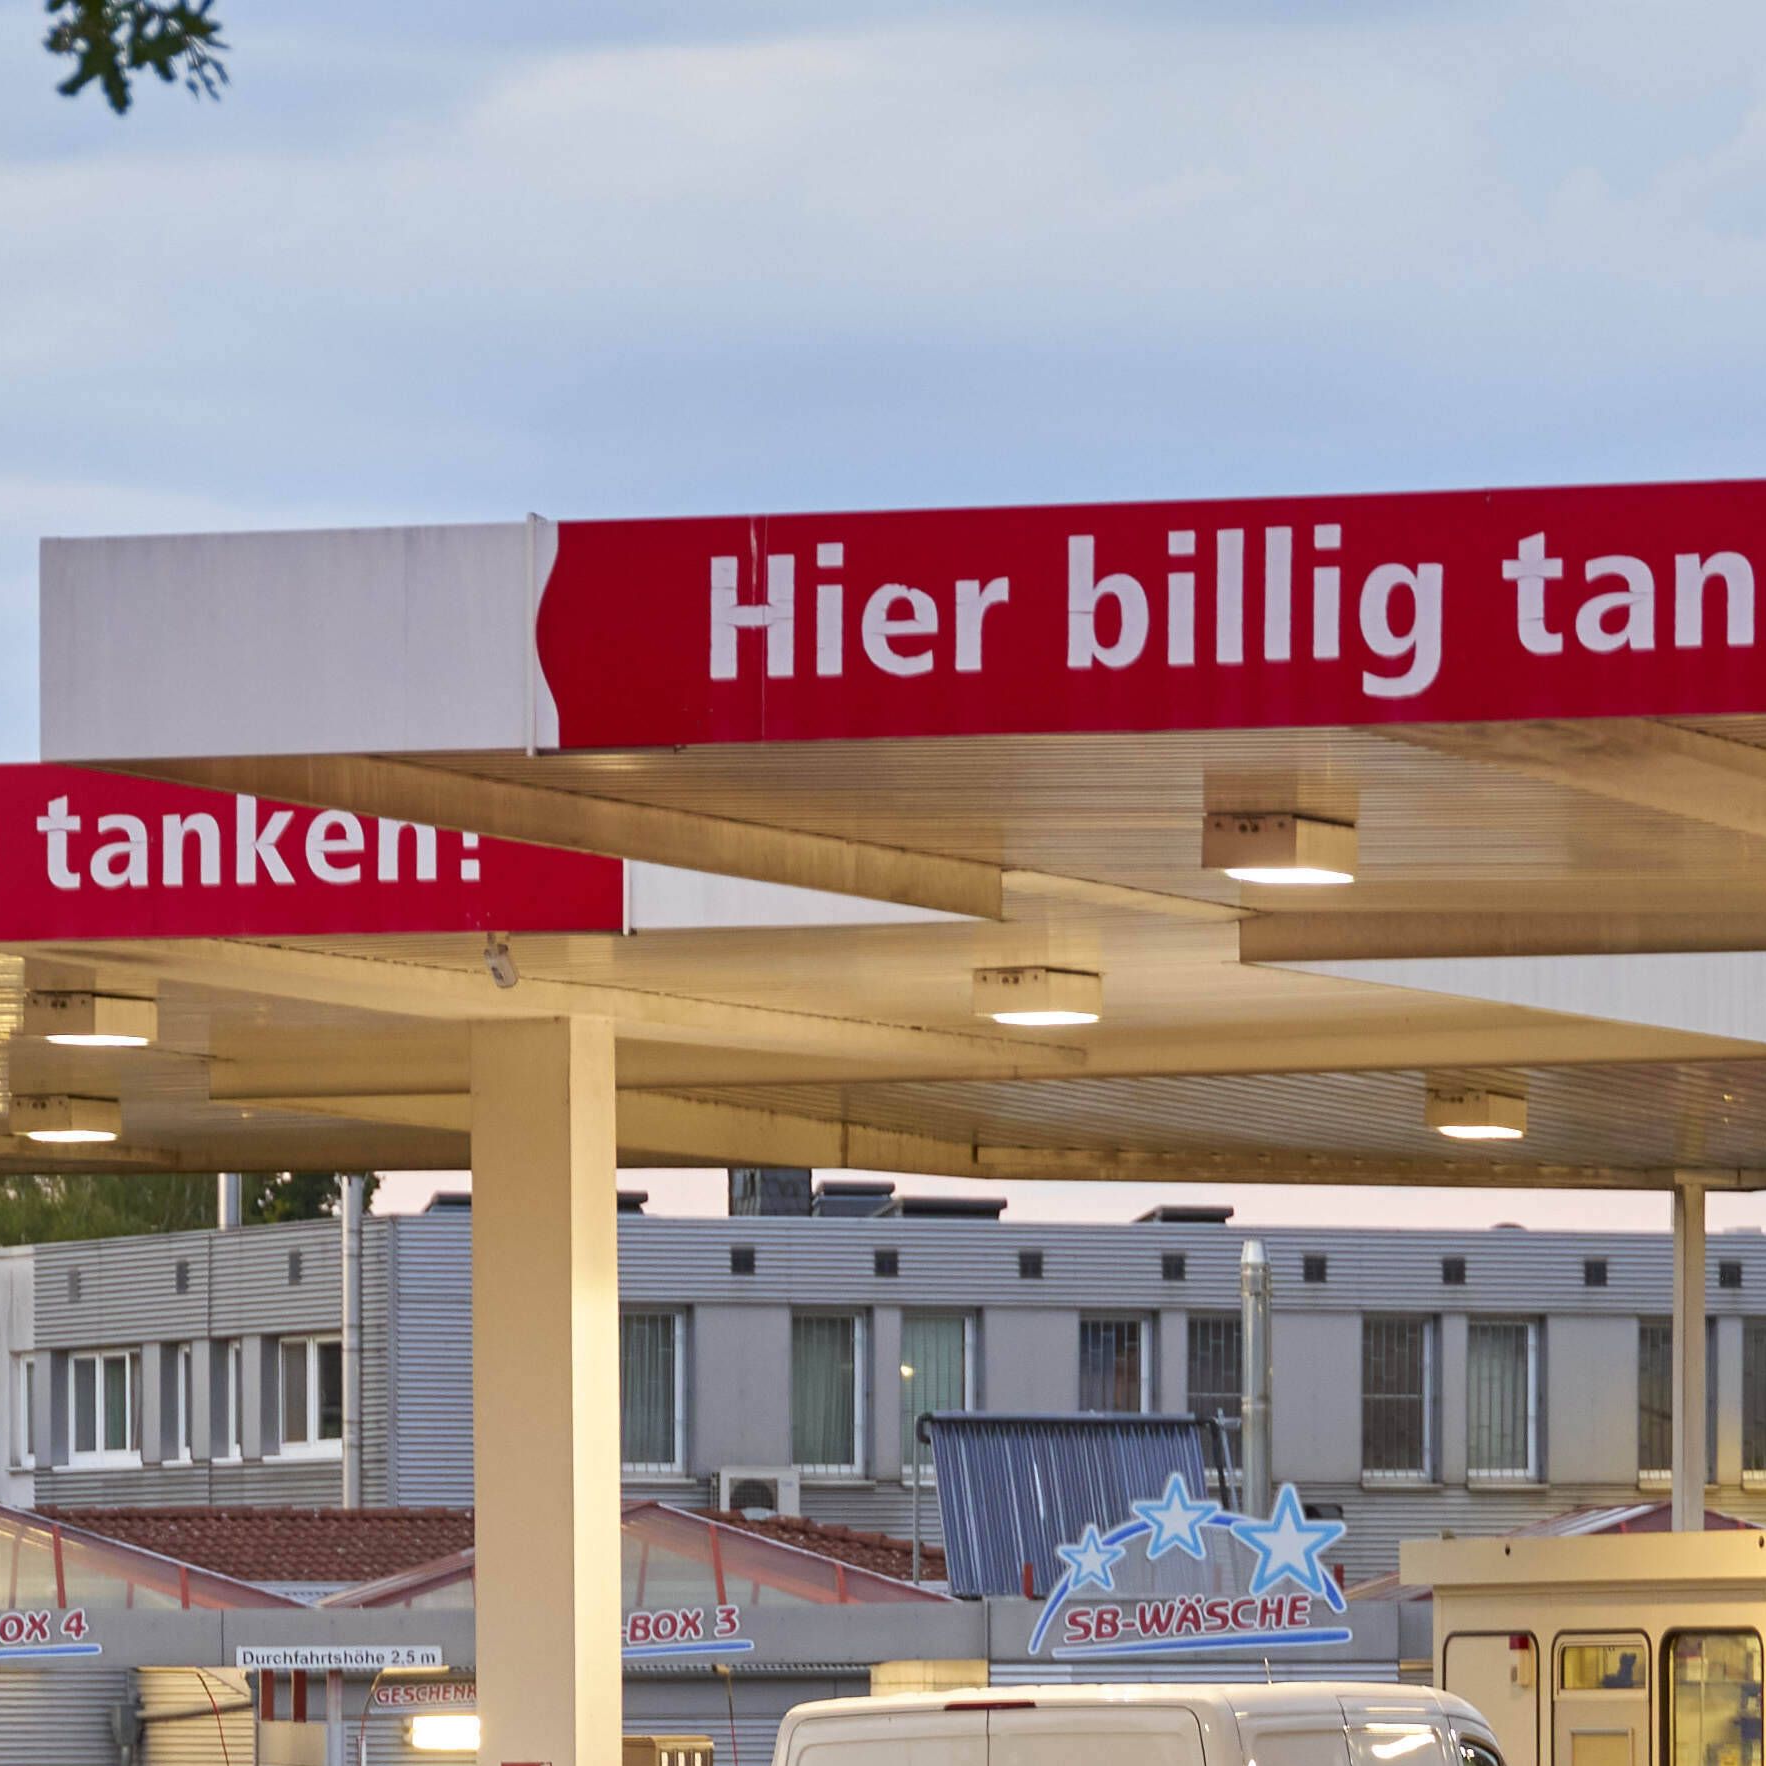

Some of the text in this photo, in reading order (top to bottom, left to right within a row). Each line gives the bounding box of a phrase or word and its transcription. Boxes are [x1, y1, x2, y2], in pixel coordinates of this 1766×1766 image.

[709, 542, 1009, 681] Hier
[1066, 523, 1444, 700] billig
[61, 1608, 89, 1640] 4
[714, 1604, 739, 1638] 3
[1063, 1593, 1312, 1643] SB-WÄSCHE
[242, 1650, 436, 1666] Durchfahrtshöhe 2,5 m
